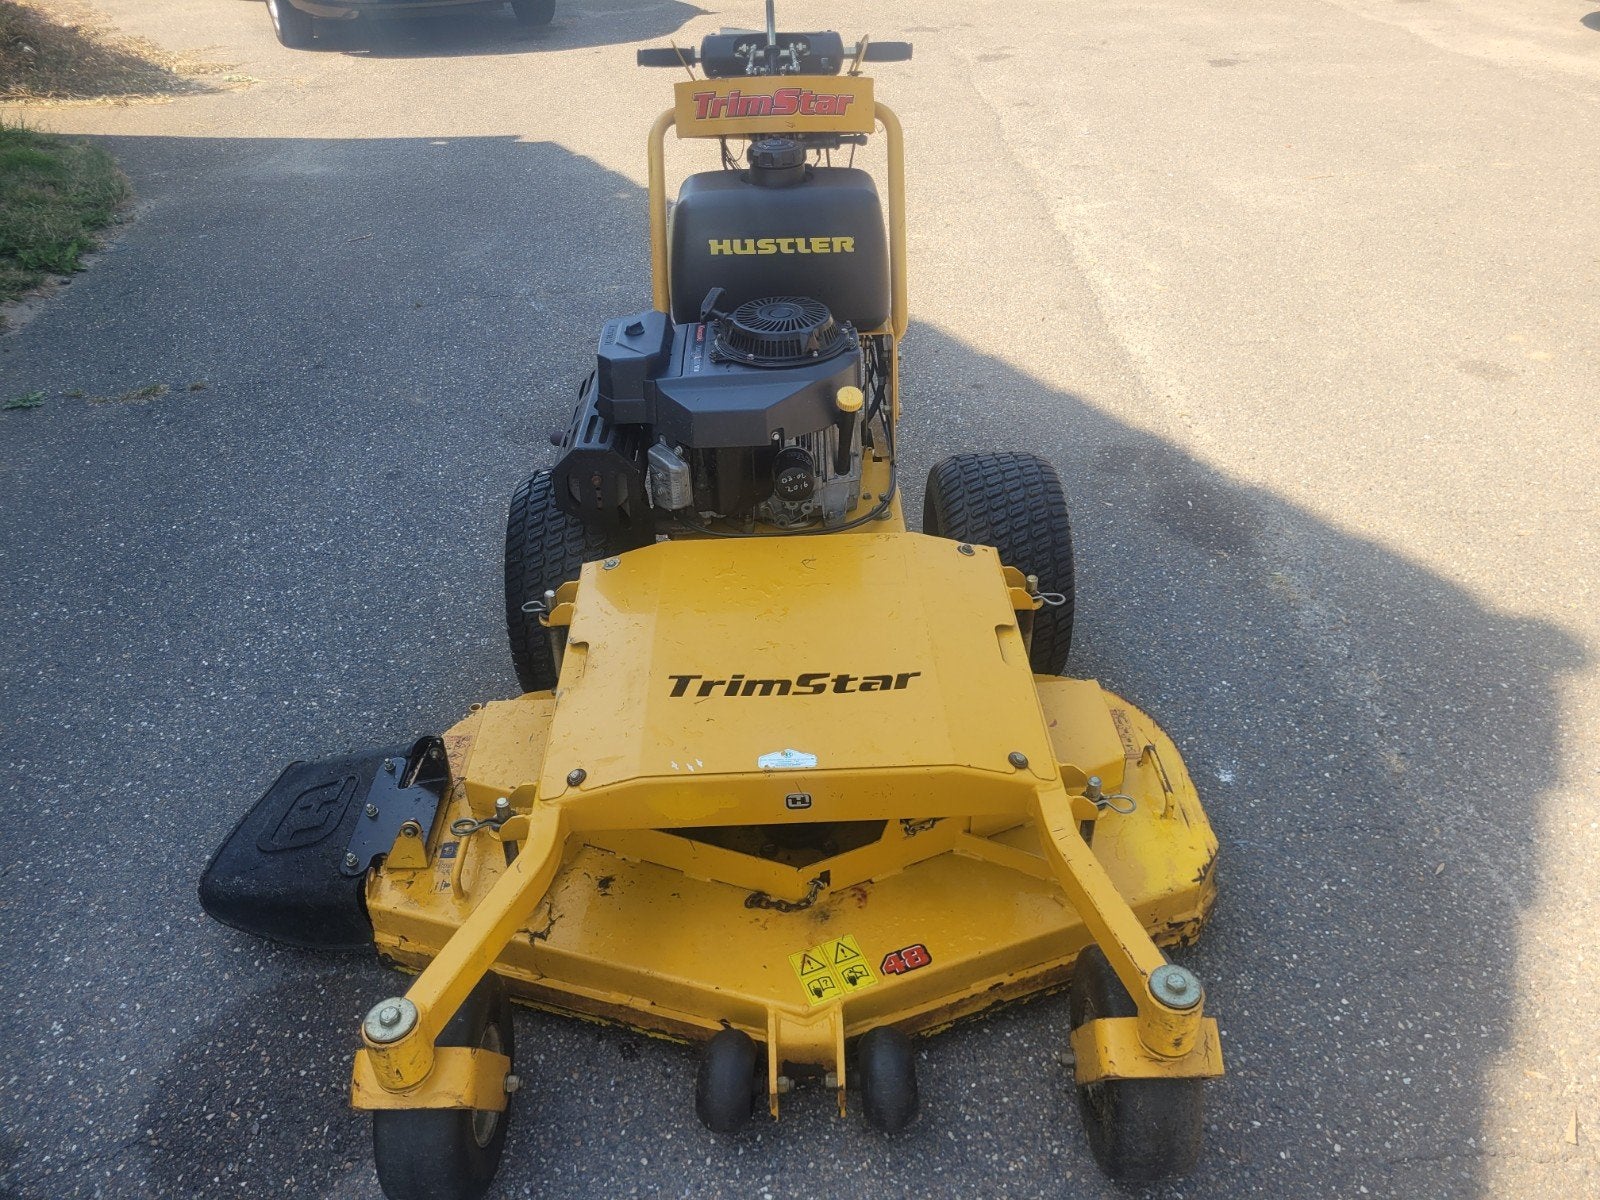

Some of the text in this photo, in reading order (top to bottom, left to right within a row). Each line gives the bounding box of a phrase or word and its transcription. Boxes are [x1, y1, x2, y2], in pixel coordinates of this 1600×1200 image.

[693, 88, 854, 119] TrimStar
[708, 236, 855, 256] HUSTLER
[668, 671, 922, 698] TrimStar
[880, 944, 932, 976] 48
